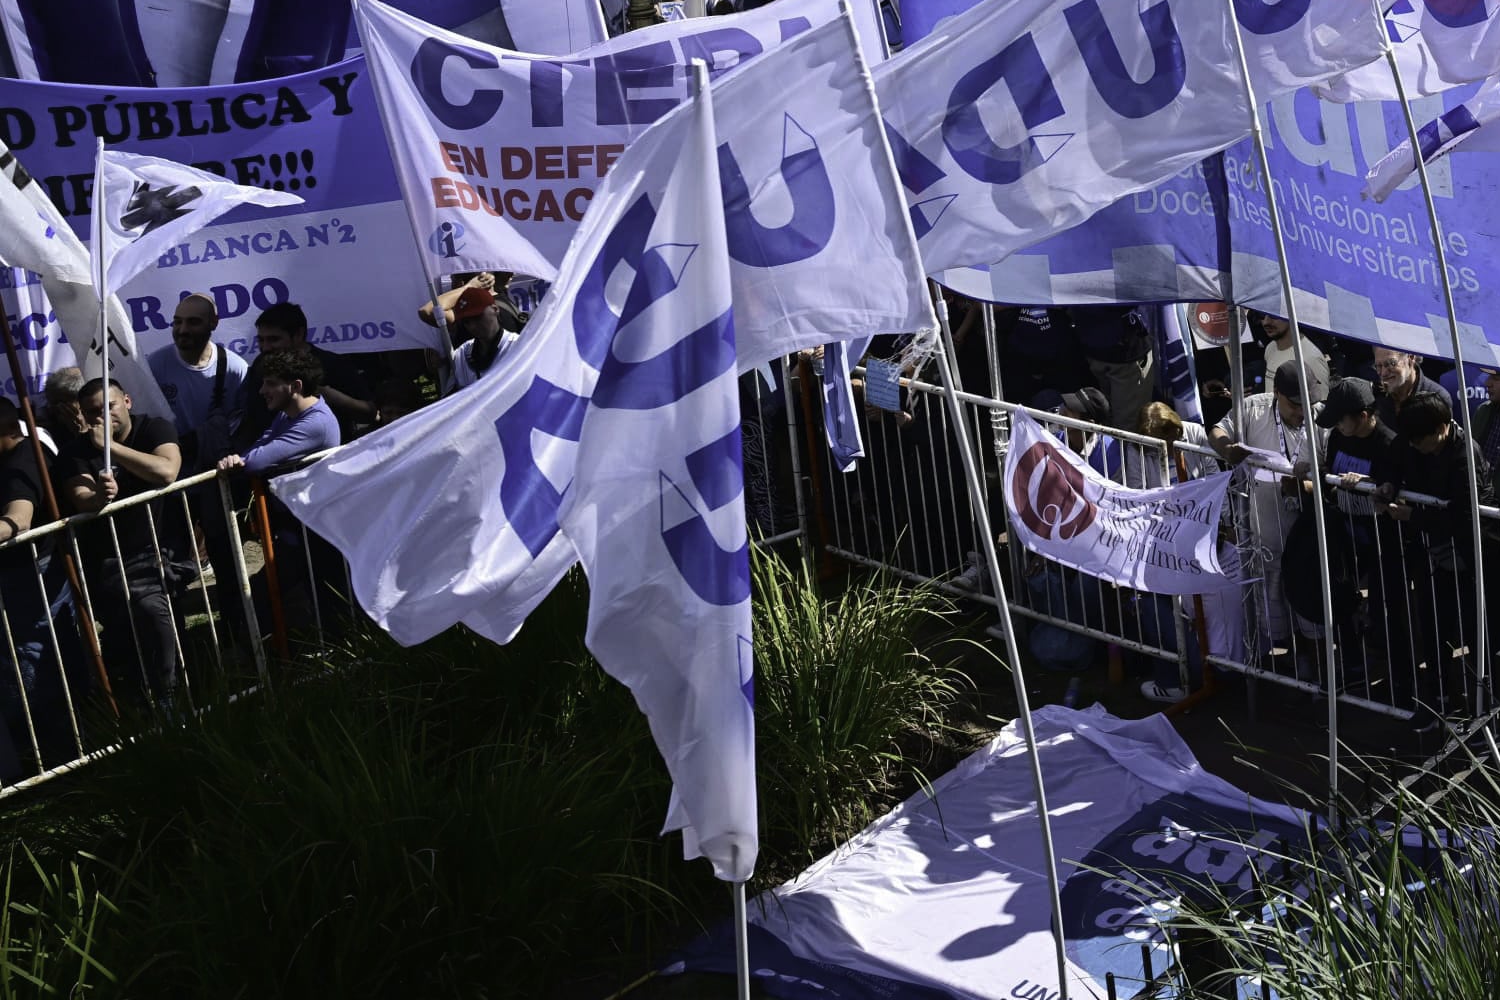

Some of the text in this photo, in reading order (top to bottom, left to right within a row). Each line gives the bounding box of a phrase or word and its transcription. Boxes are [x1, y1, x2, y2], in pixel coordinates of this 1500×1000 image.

[48, 85, 314, 149] PÚBLICA
[320, 71, 360, 117] Y
[411, 15, 813, 131] CTER
[438, 140, 489, 180] EN
[431, 177, 600, 224] EDUCAC
[1133, 187, 1481, 293] Docentes Universitarios
[1290, 176, 1418, 247] Nacional
[1428, 217, 1469, 257] de
